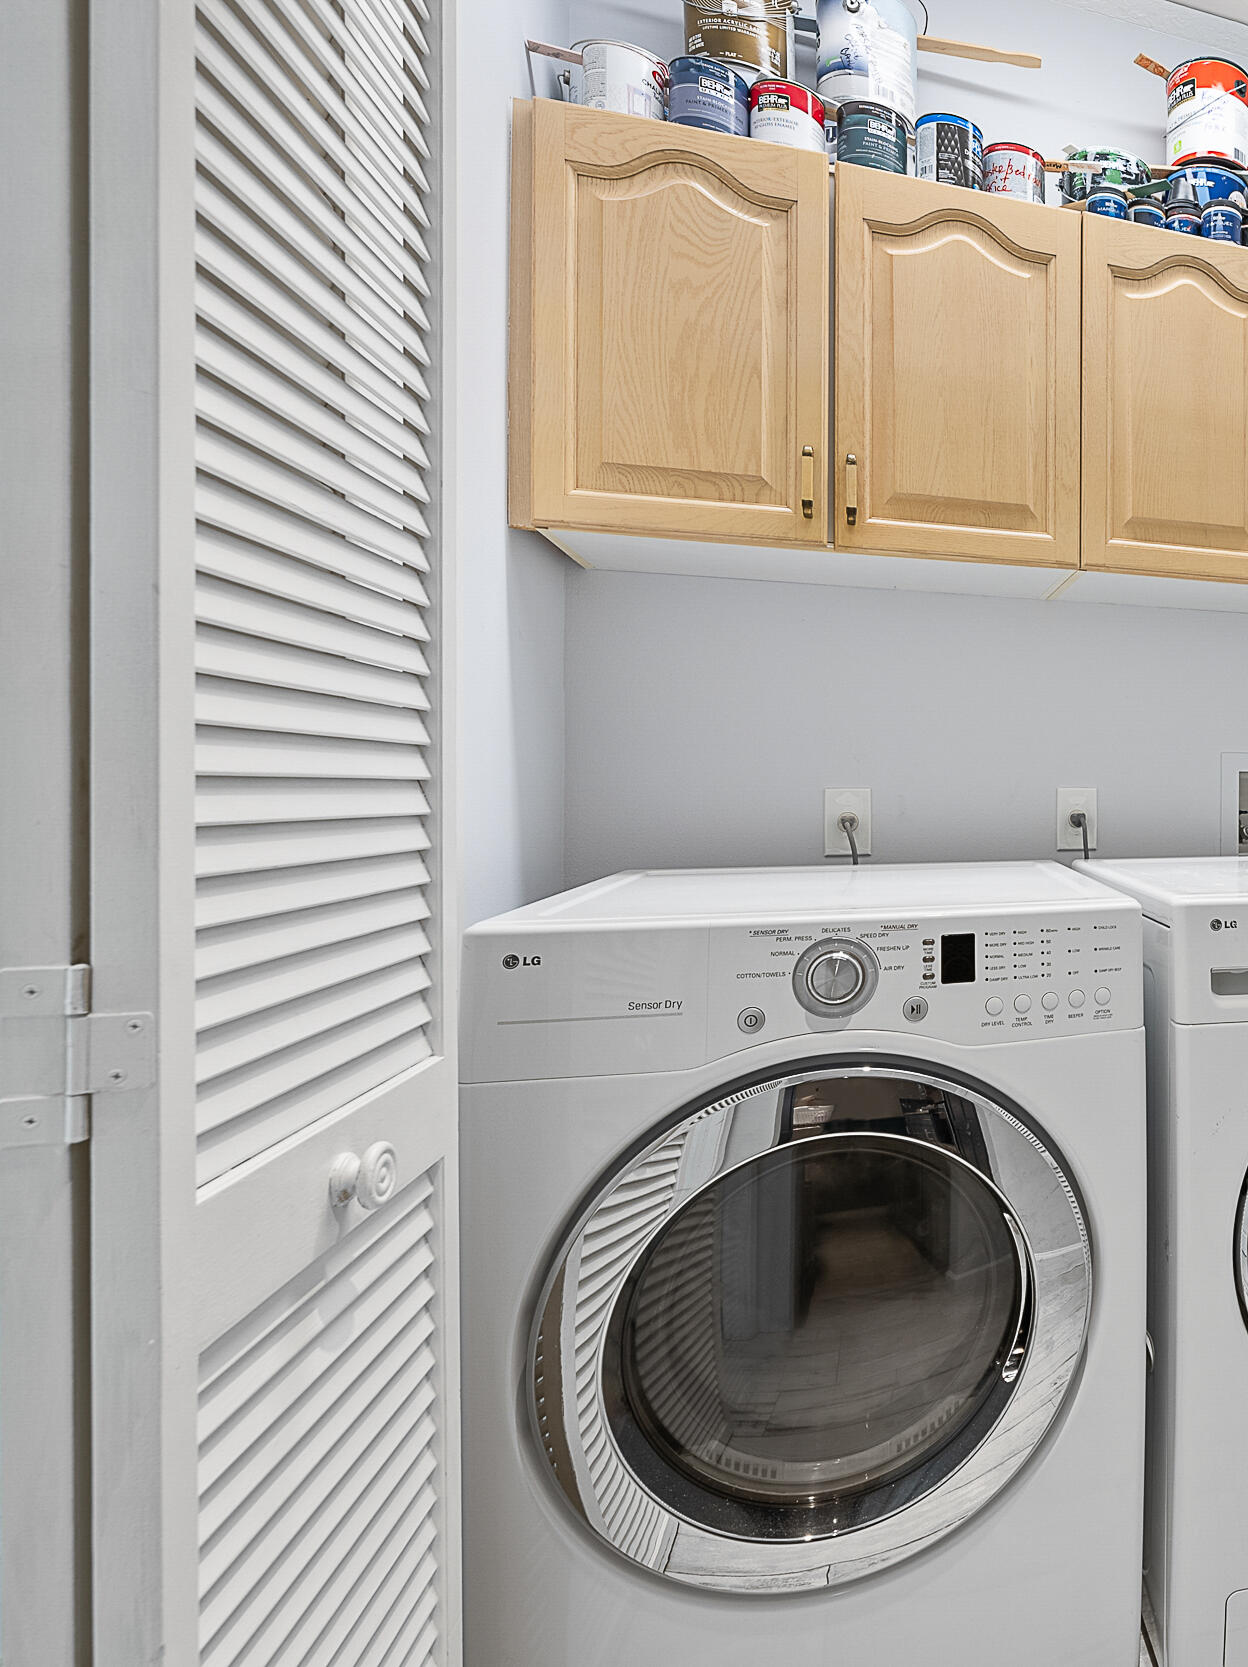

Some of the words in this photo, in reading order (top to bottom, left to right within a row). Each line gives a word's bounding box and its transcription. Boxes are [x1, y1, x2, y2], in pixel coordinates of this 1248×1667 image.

[697, 18, 721, 26] EXTERIOR
[723, 19, 748, 29] ACRYLIC
[701, 79, 724, 93] BEHR
[758, 95, 778, 104] BEHR
[870, 120, 888, 132] BEHR
[862, 141, 877, 149] PAINT
[1224, 920, 1238, 929] LG
[522, 956, 542, 966] LG
[628, 1001, 662, 1011] Sensor
[664, 999, 683, 1010] Dry
